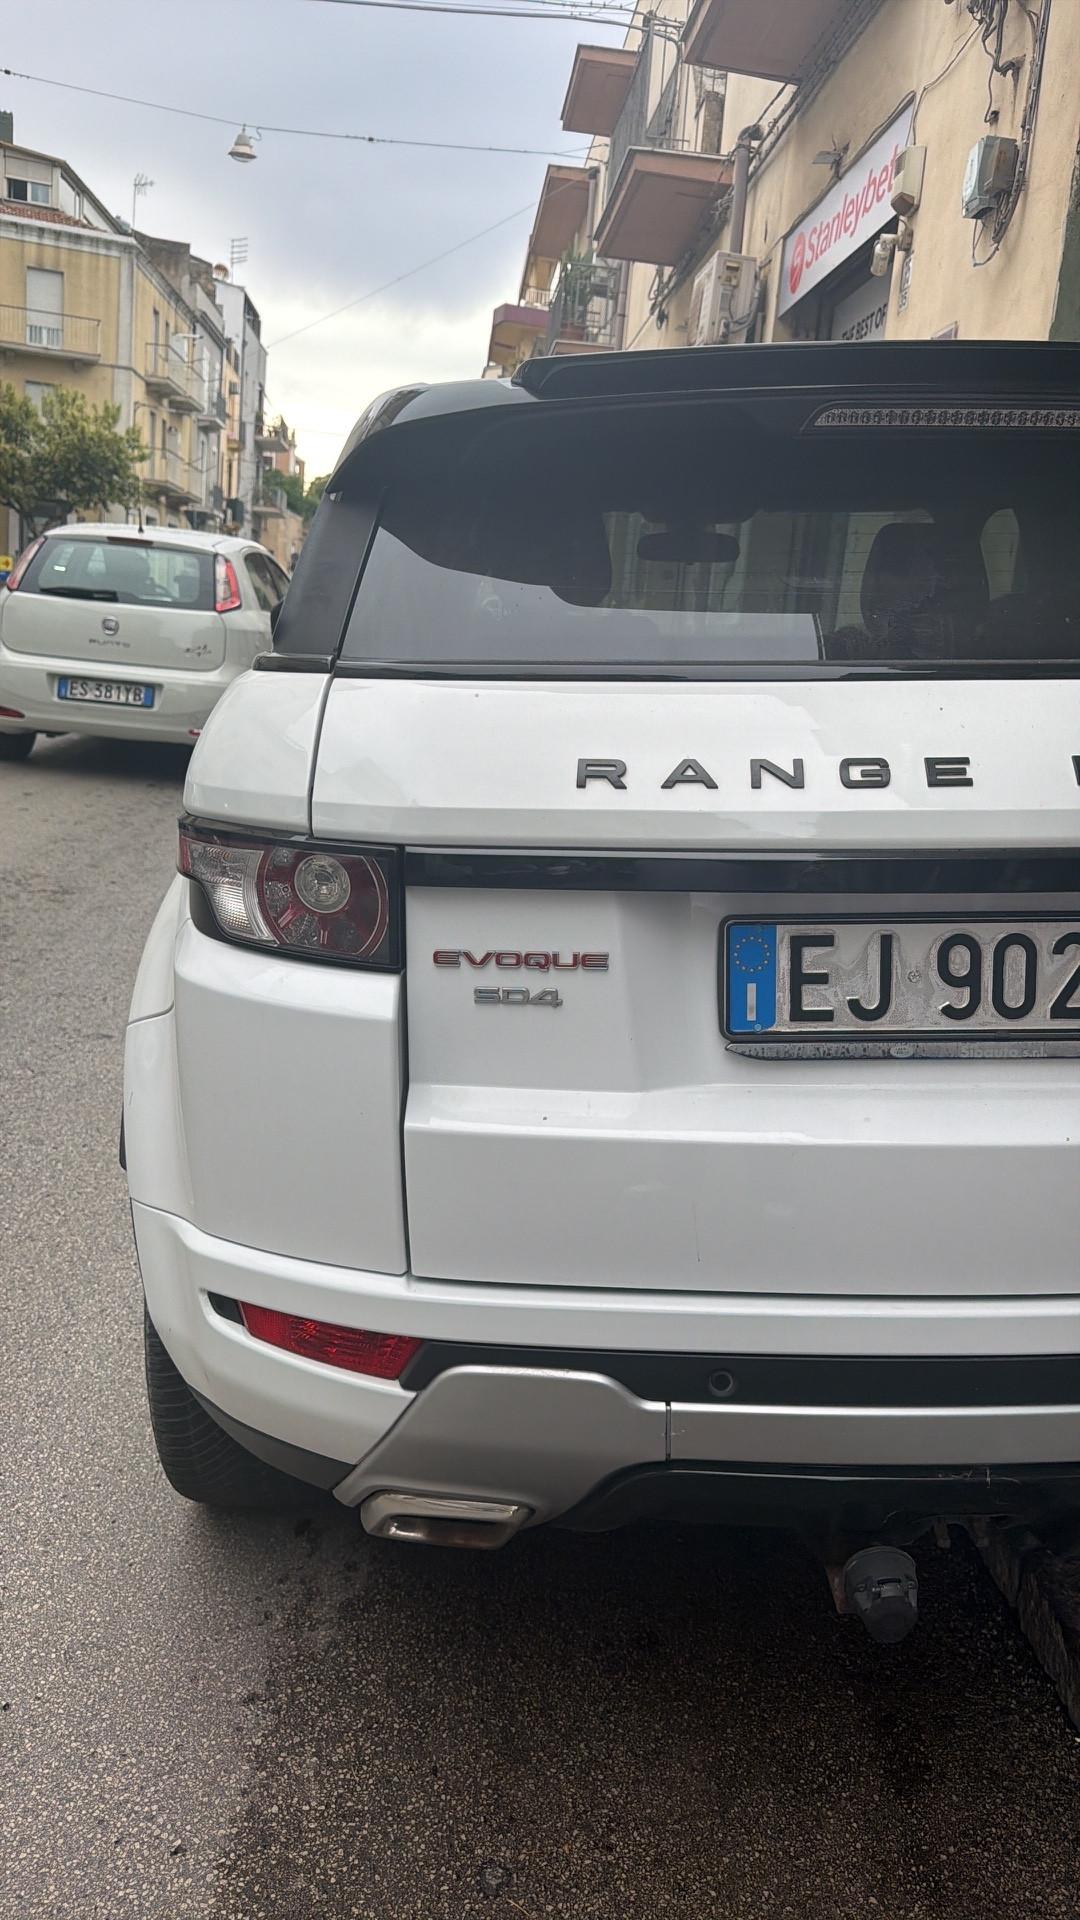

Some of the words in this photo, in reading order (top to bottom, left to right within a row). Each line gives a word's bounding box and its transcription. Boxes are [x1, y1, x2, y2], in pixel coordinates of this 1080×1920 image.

[804, 143, 900, 270] Stanleybet
[69, 680, 89, 697] ES
[576, 756, 974, 790] RANGE
[432, 949, 610, 973] EVOQUE
[788, 932, 894, 1023] EJ
[473, 985, 564, 1009] SD4
